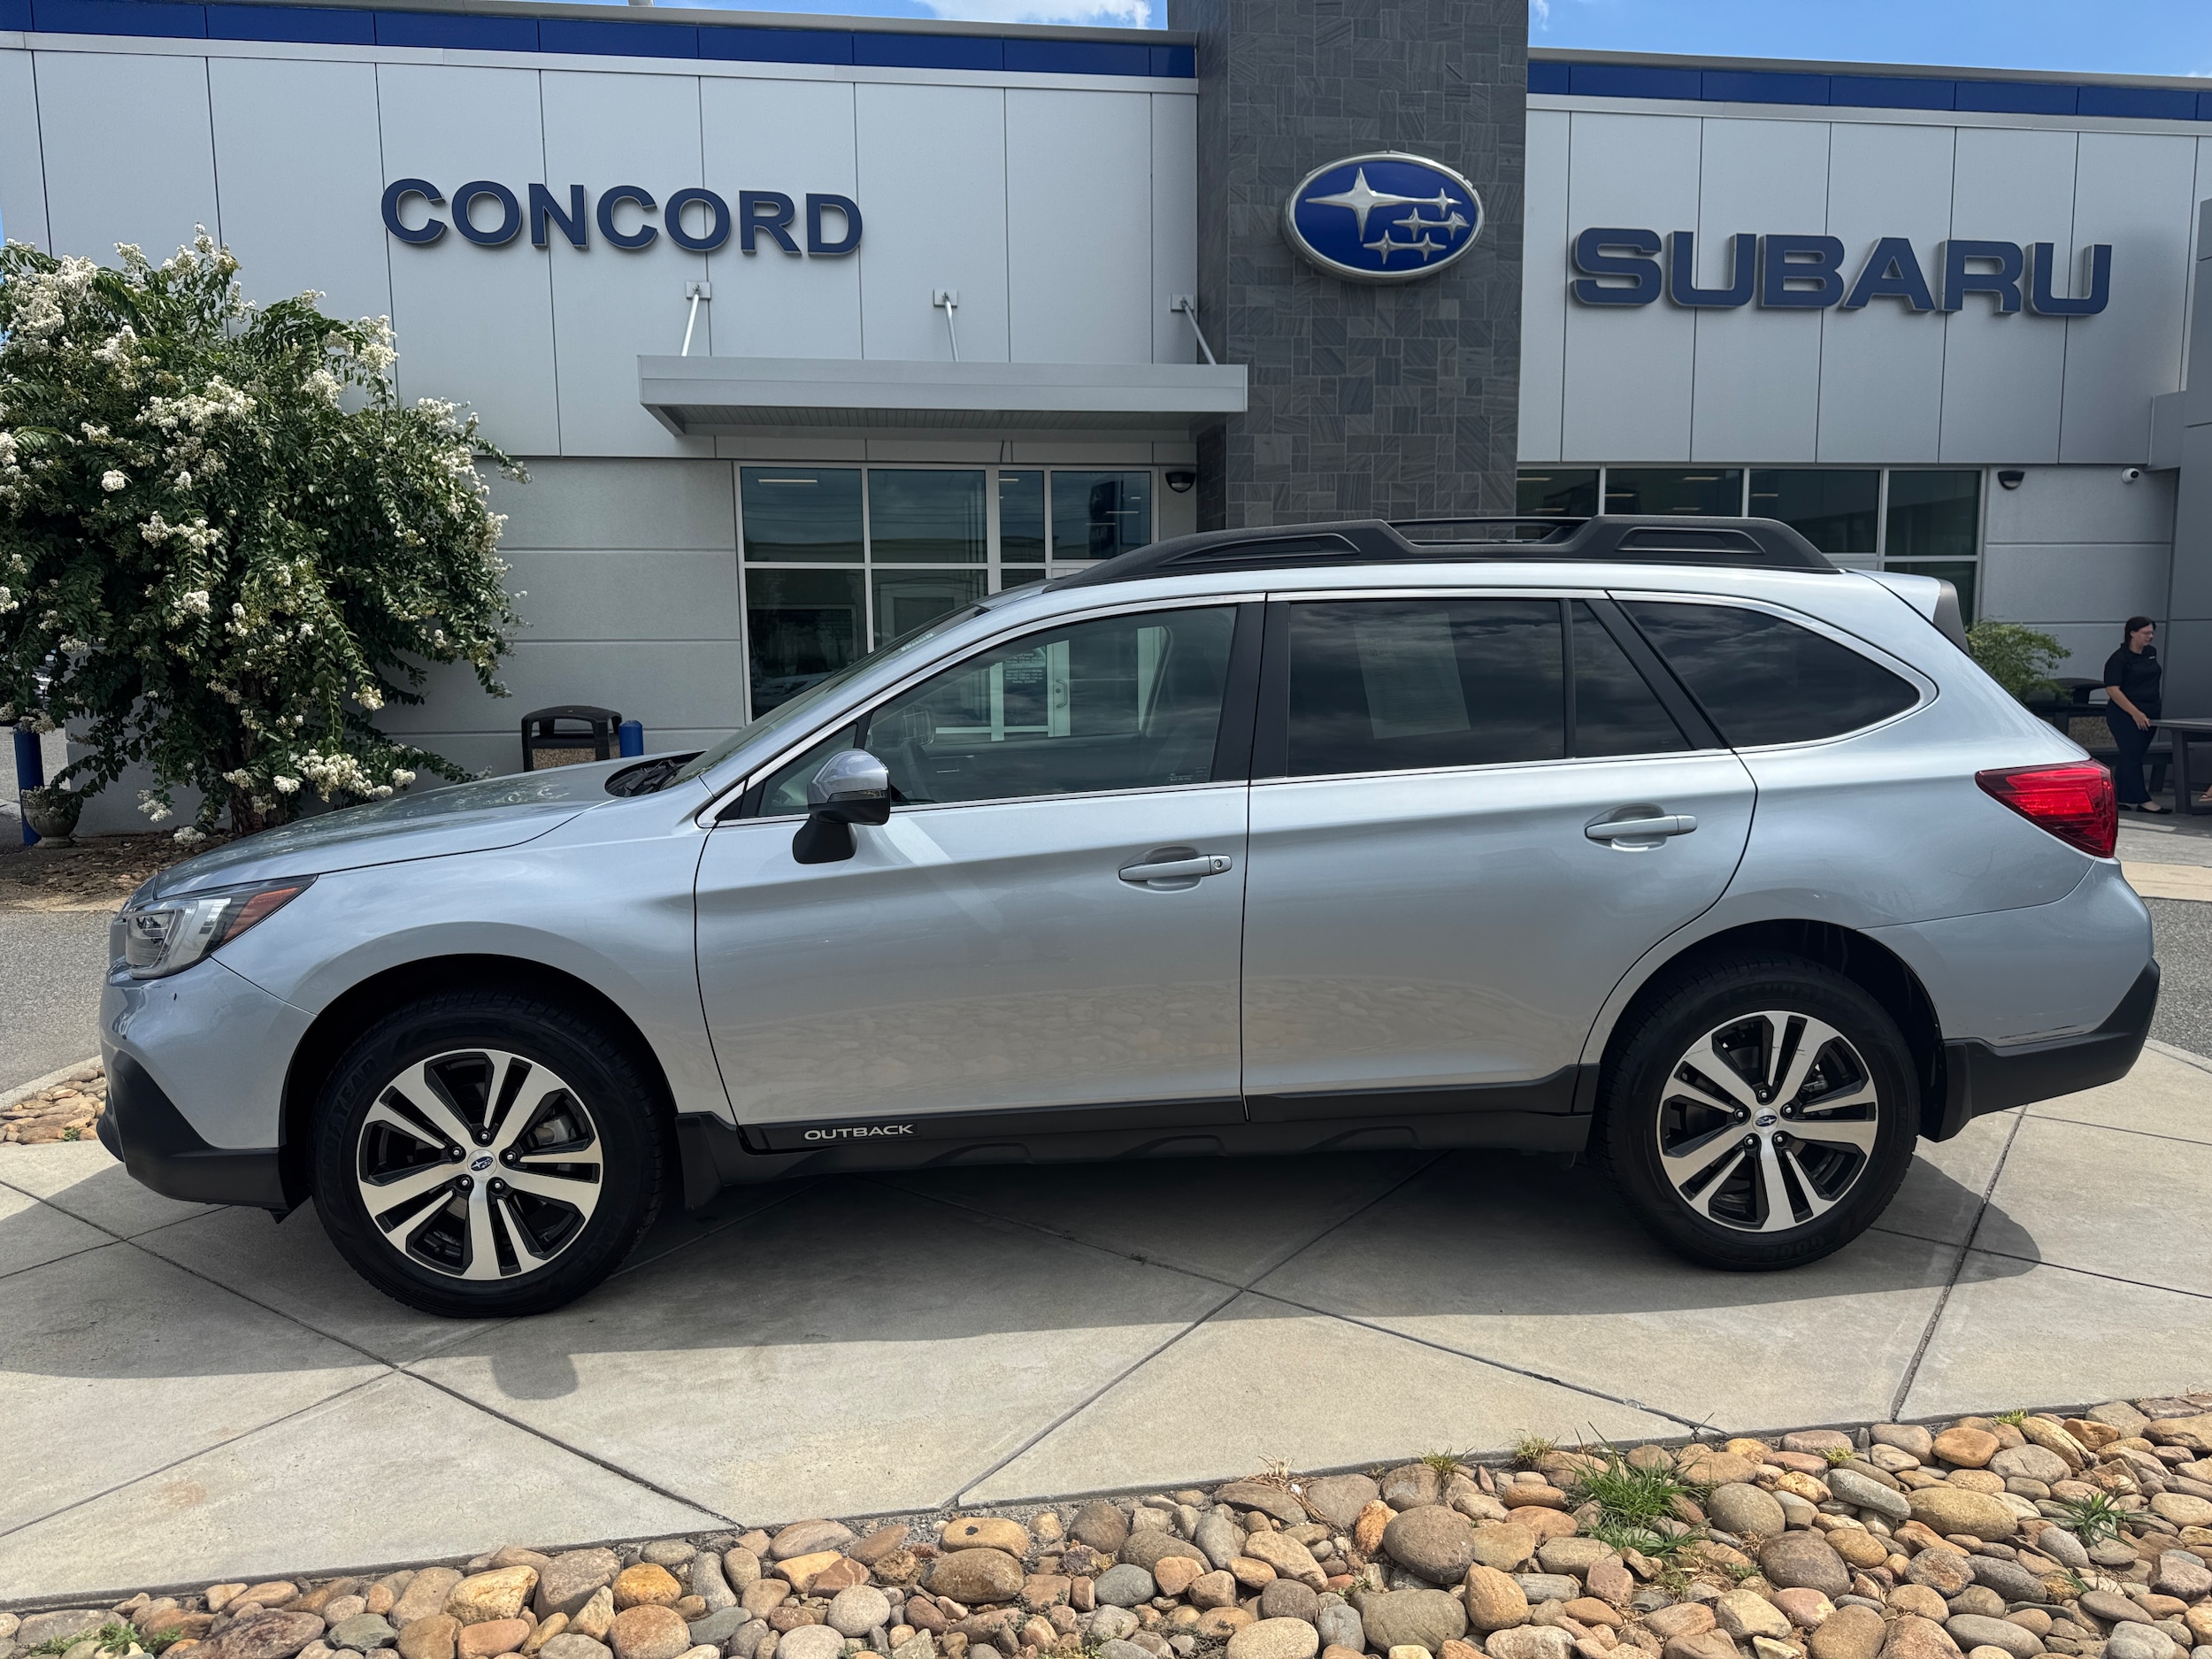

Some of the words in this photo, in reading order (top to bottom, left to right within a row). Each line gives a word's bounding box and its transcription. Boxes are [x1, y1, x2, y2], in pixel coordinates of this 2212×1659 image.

[380, 178, 864, 259] CONCORD
[1570, 227, 2113, 317] SUBARU
[803, 1124, 914, 1141] OUTBACK
